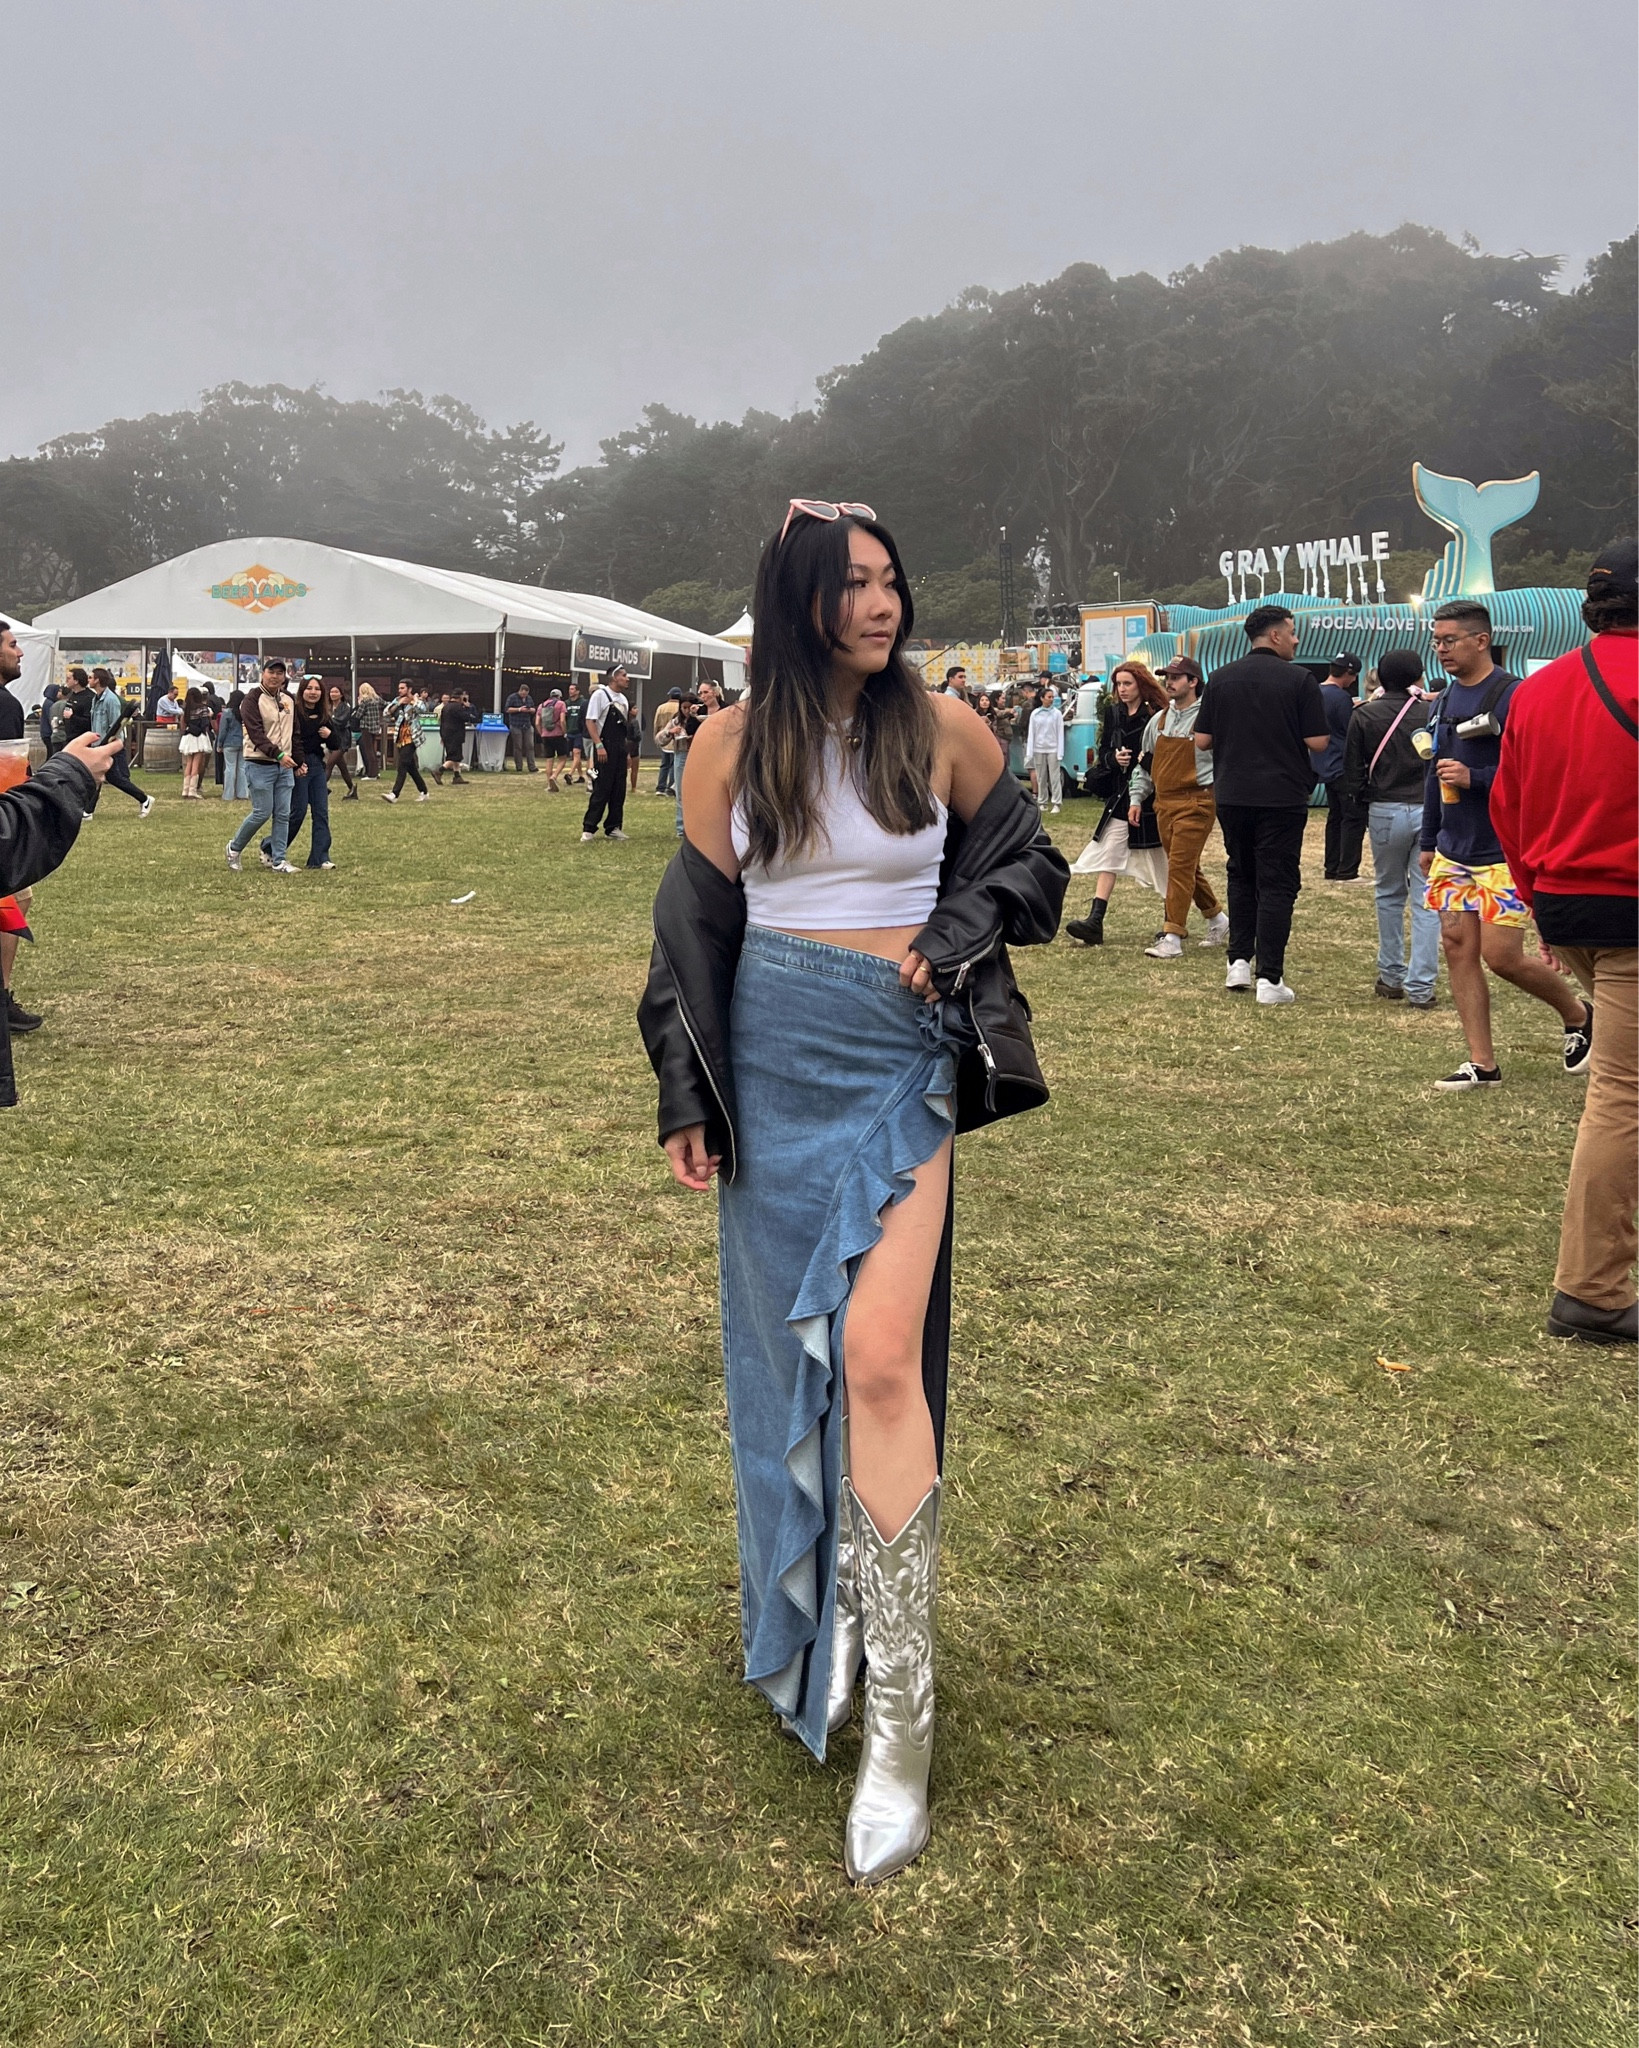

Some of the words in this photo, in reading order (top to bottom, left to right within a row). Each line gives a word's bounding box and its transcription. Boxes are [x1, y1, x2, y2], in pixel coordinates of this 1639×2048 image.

[1219, 545, 1290, 577] GRAY
[1296, 531, 1390, 570] WHALE
[212, 584, 249, 599] BEER
[1310, 616, 1415, 631] #OCEANLOVE
[1492, 625, 1519, 633] WHALE
[1521, 625, 1535, 633] GIN
[588, 644, 610, 662] BEER
[612, 647, 639, 665] LANDS
